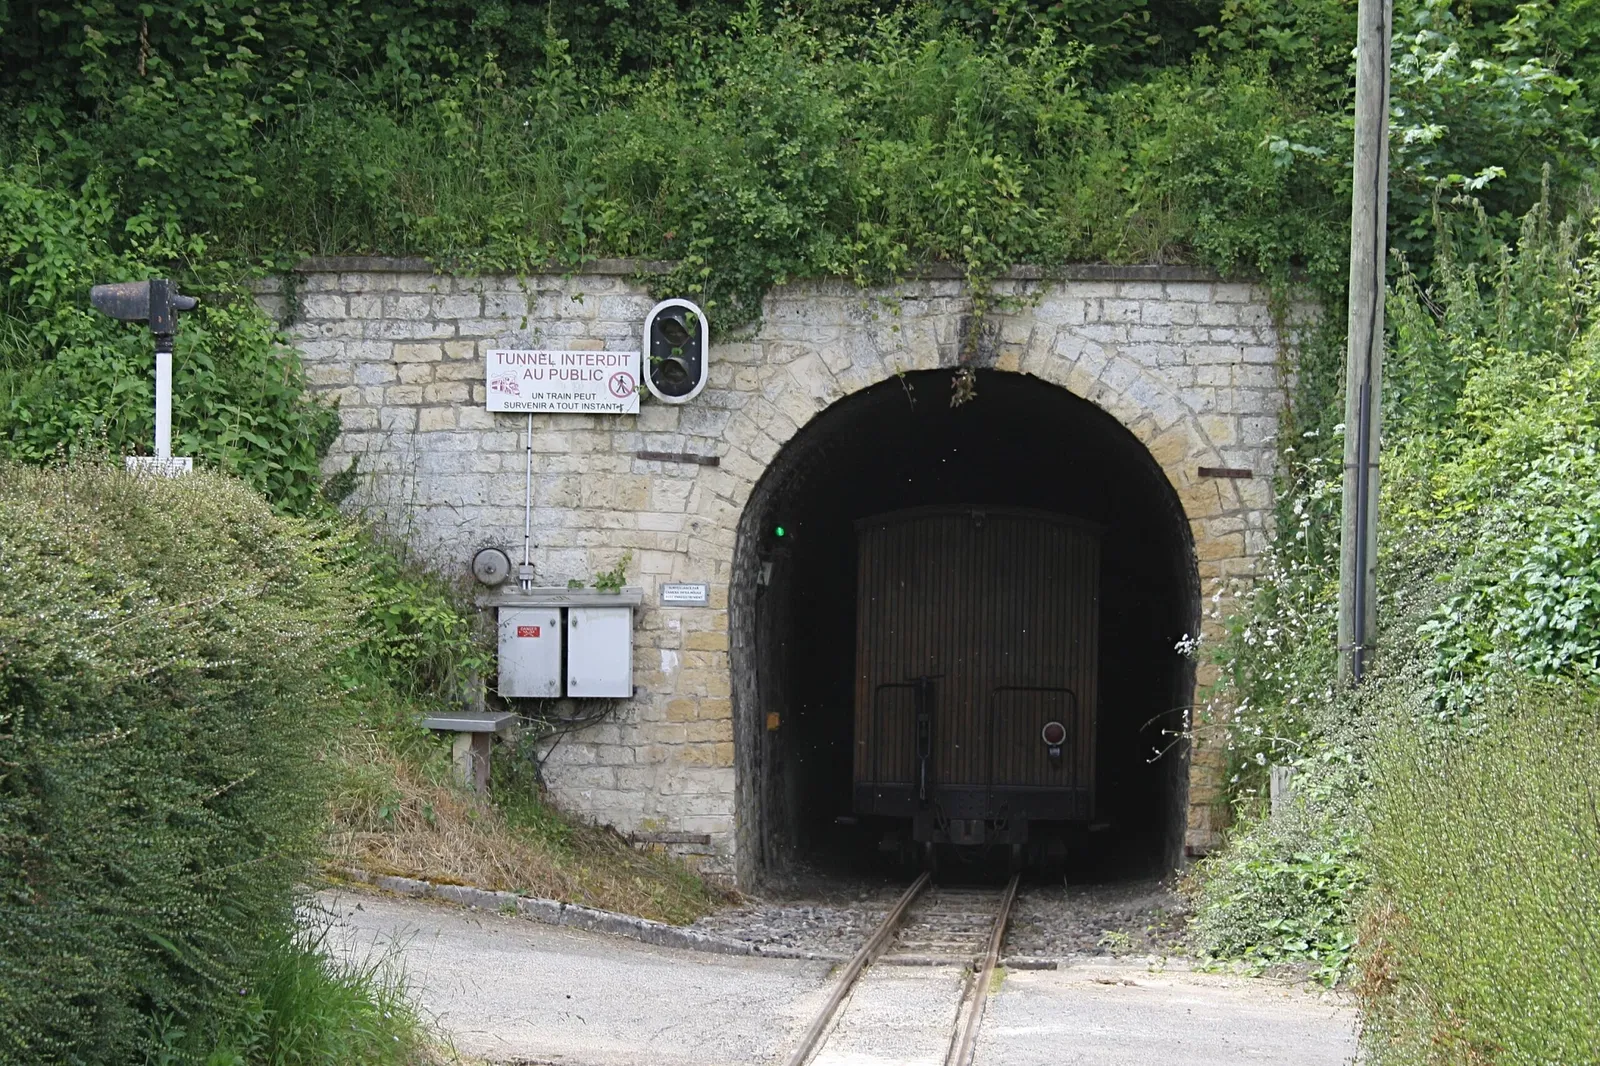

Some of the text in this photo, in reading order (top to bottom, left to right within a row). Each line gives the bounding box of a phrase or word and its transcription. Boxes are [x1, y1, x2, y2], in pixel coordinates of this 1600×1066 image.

[496, 353, 630, 366] TUNNEL INTERDIT
[523, 369, 603, 381] AU PUBLIC
